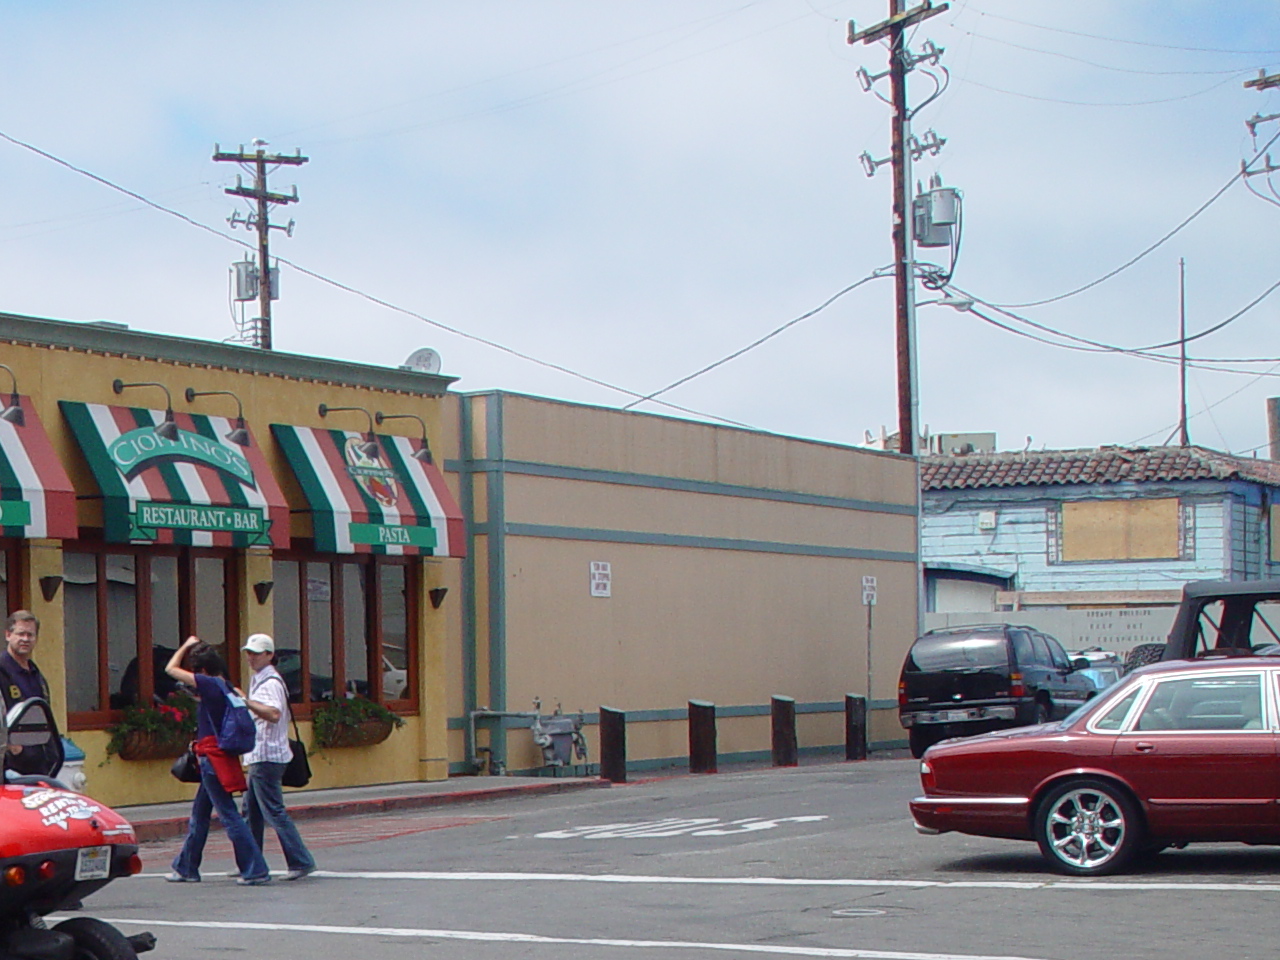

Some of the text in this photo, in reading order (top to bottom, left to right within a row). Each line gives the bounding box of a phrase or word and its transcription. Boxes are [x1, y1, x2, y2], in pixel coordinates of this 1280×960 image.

[113, 432, 249, 477] CIOPINO'S
[142, 506, 259, 529] RESTAURANT BAR
[379, 526, 411, 543] PASTA
